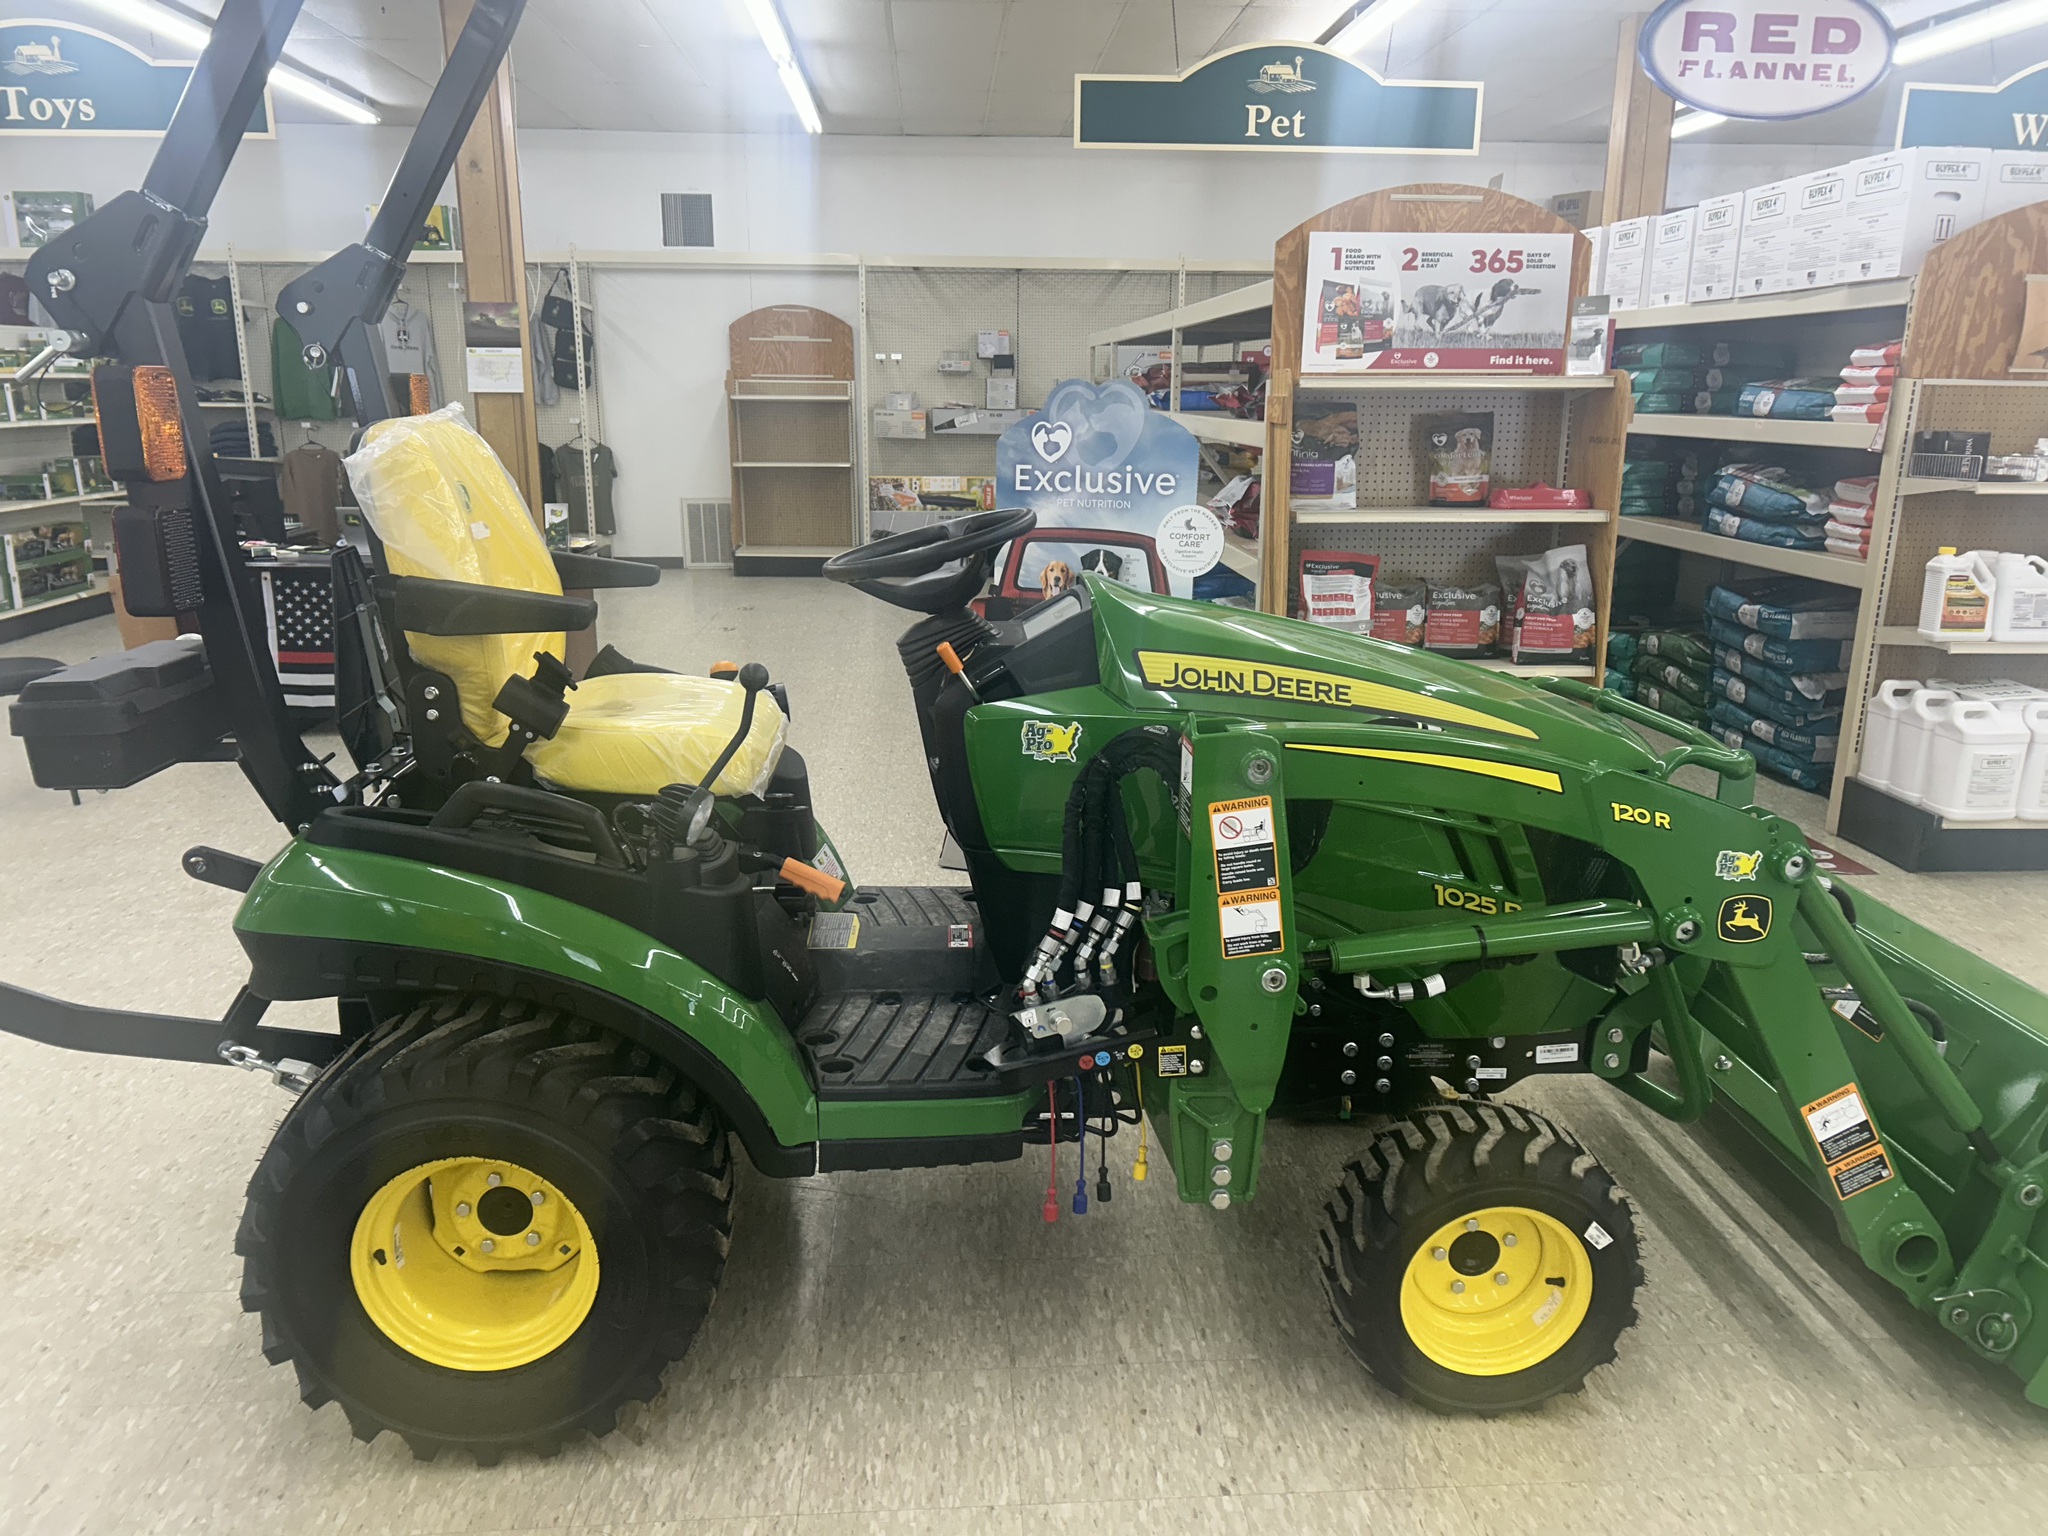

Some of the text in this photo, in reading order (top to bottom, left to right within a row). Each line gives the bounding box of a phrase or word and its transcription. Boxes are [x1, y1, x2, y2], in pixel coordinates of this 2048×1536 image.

[1681, 11, 1862, 54] RED
[1678, 59, 1855, 83] FLANNEL
[0, 86, 95, 129] Toys
[1244, 104, 1306, 138] Pet
[2012, 113, 2048, 146] W
[1864, 172, 1885, 186] GLYPEX
[1808, 187, 1828, 200] GLYPEX
[1331, 247, 1342, 271] 1
[1401, 247, 1419, 271] 2
[1469, 248, 1524, 273] 365
[1490, 355, 1553, 365] Find it here.
[1015, 464, 1176, 496] Exclusive
[1057, 499, 1131, 509] PET NUTRITION
[1163, 516, 1173, 528] ONLY
[1202, 512, 1218, 530] MAKERS
[1198, 551, 1218, 571] NUTRITION
[1376, 591, 1403, 599] lusive
[1433, 591, 1476, 600] Exclusive
[1527, 594, 1568, 608] Exclusive
[1163, 662, 1352, 703] JOHN DEERE
[1025, 724, 1051, 739] Ag-
[1790, 732, 1811, 744] FLANNEL
[1026, 738, 1053, 750] Pro
[1221, 798, 1268, 812] WARNING
[1611, 802, 1671, 830] 120 R
[1230, 891, 1276, 904] WARNING
[1433, 883, 1498, 915] 1025
[1816, 1088, 1850, 1107] WARNING
[1844, 1149, 1878, 1168] WARNING
